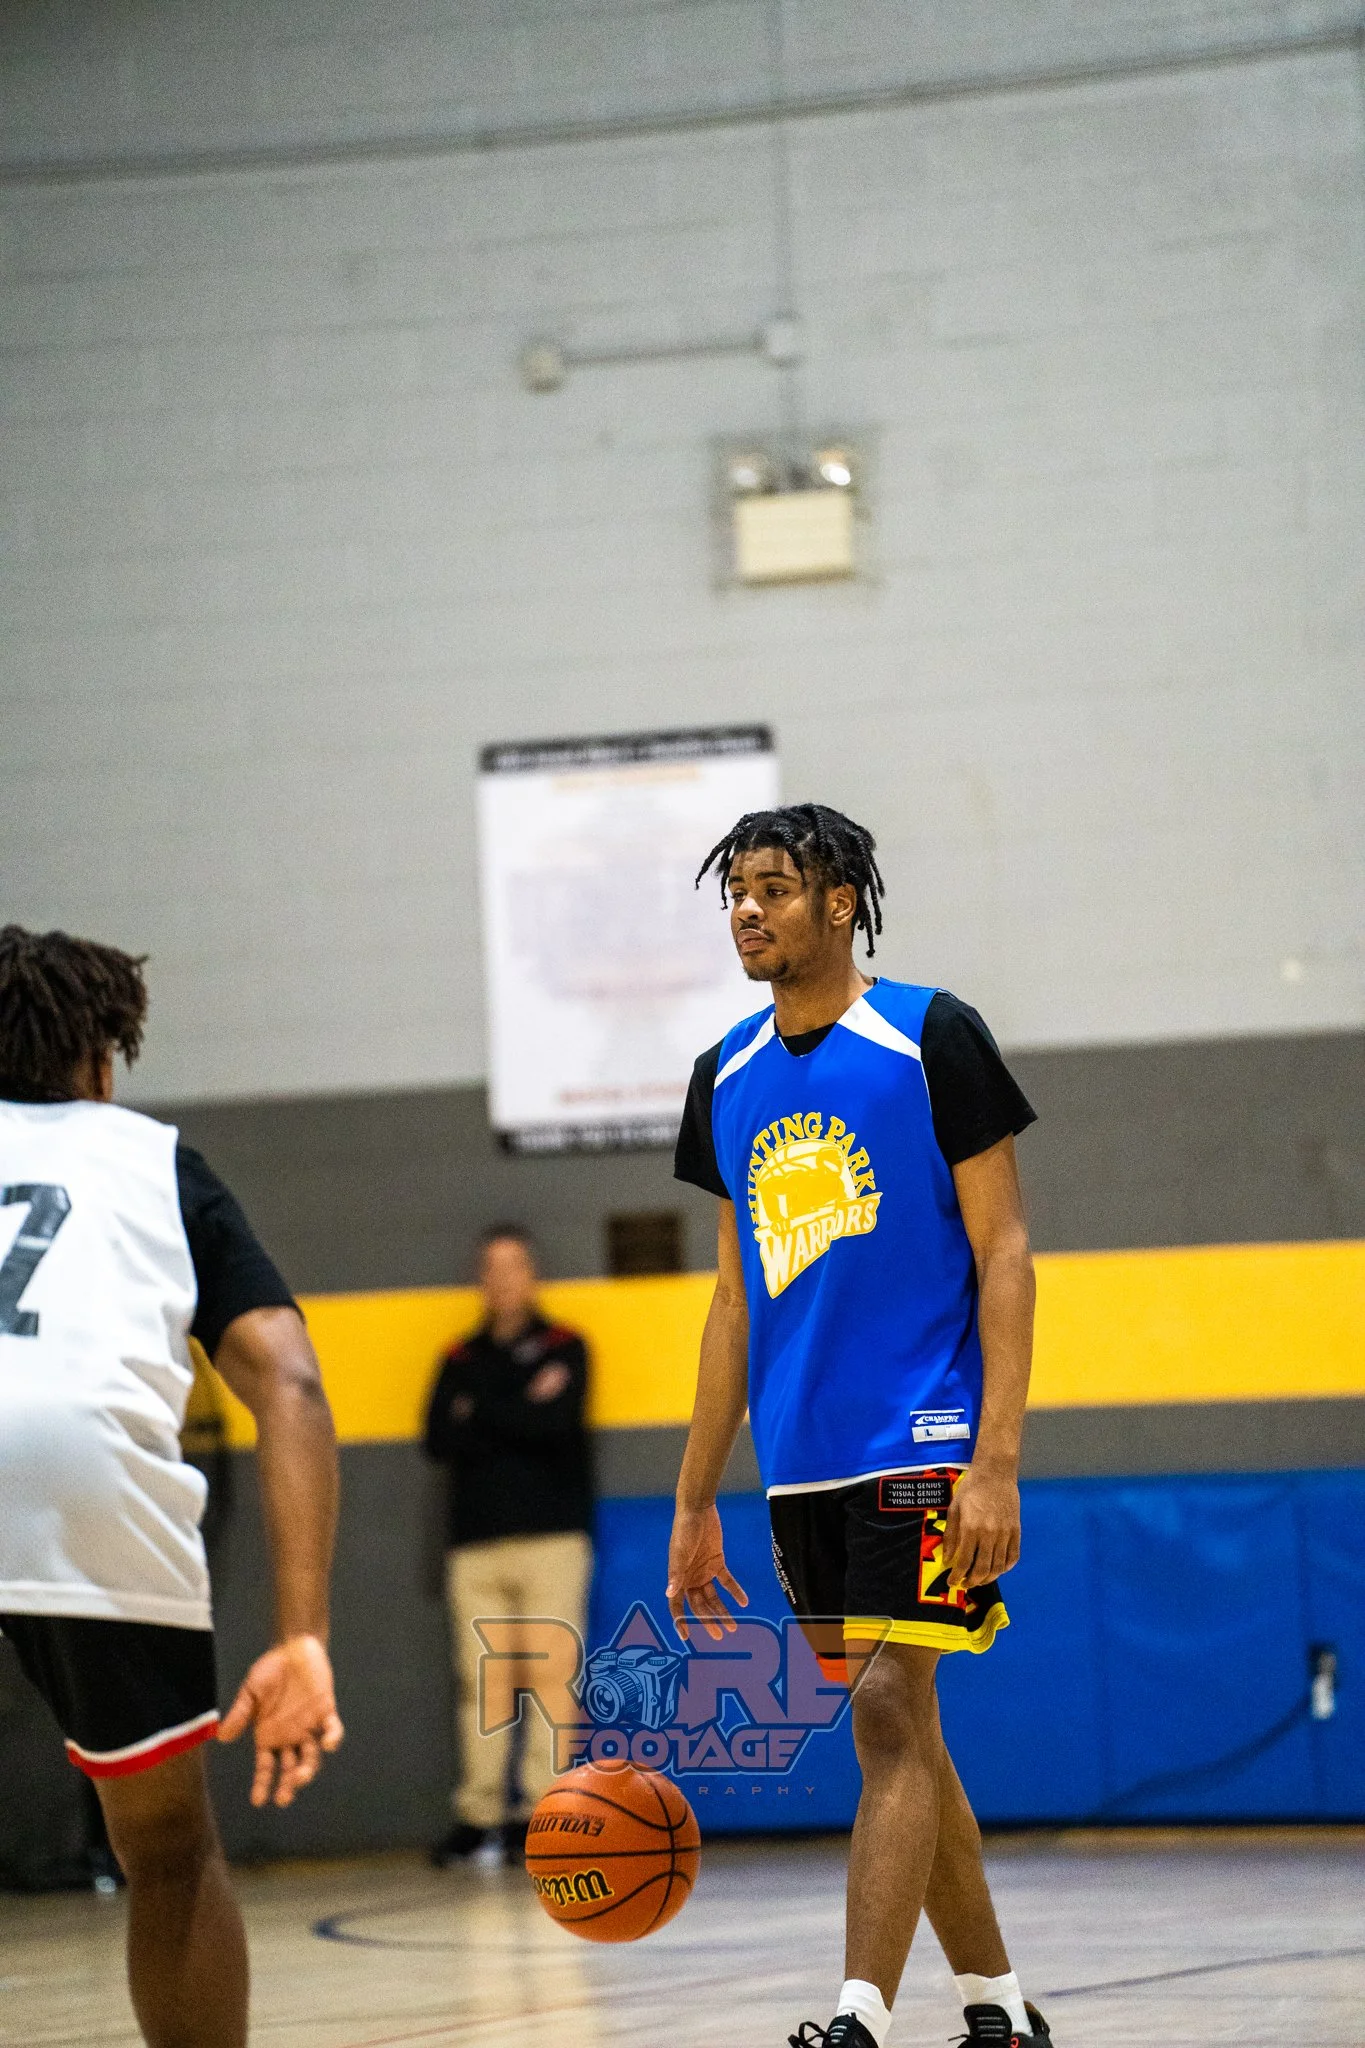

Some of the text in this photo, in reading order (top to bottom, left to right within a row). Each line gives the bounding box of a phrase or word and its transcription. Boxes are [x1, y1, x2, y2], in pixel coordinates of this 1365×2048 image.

[748, 1112, 876, 1225] HUNTING PARK
[0, 1183, 73, 1339] 7
[754, 1200, 877, 1299] WARRORS
[925, 1428, 933, 1436] L
[532, 1868, 615, 1908] Wilso
